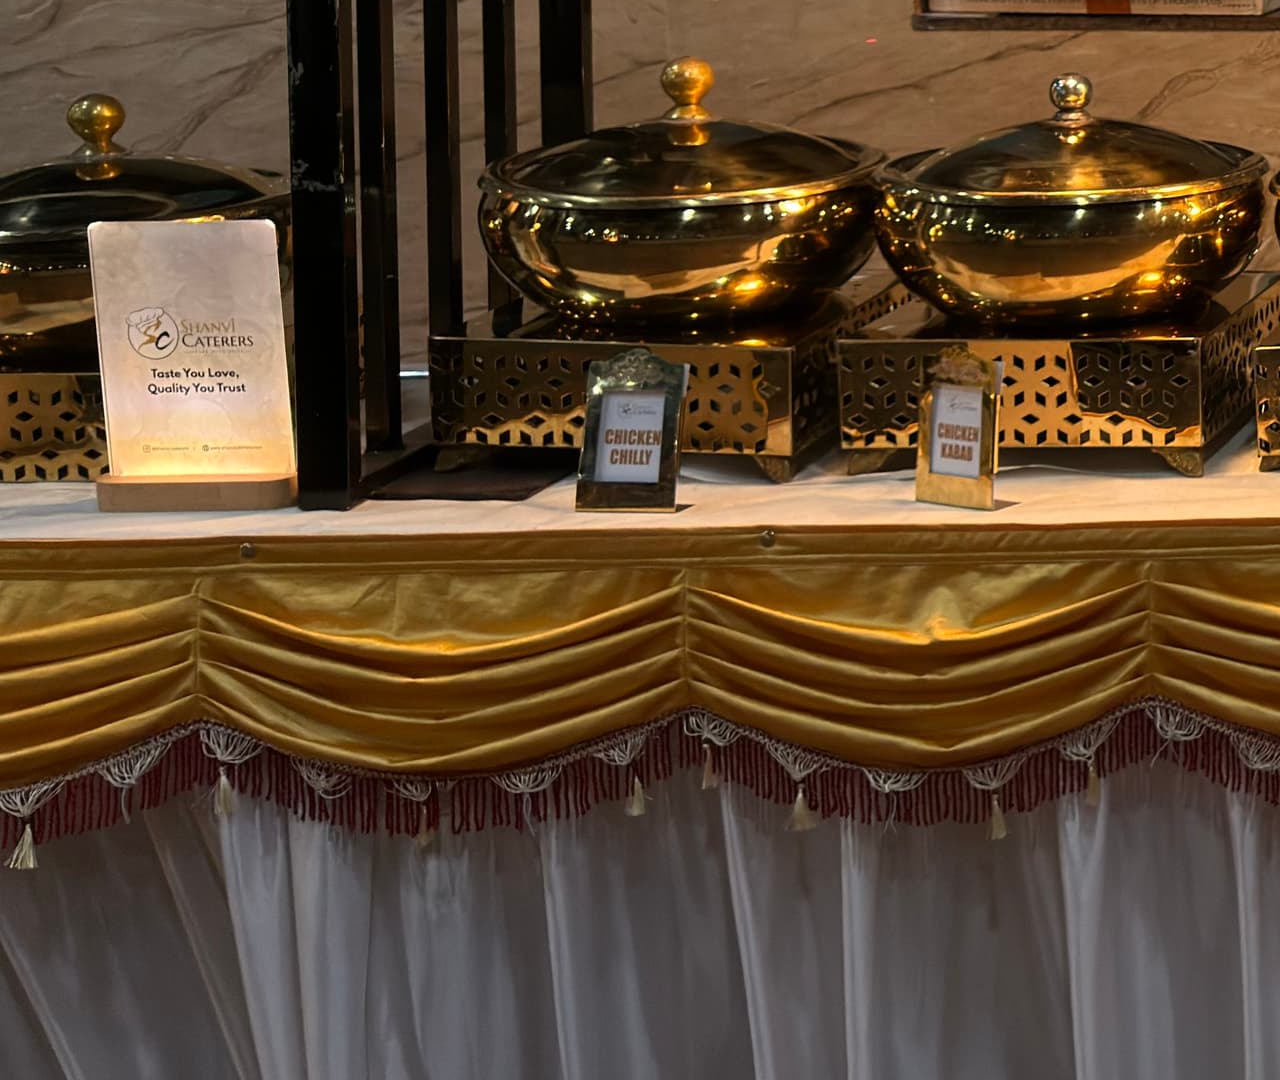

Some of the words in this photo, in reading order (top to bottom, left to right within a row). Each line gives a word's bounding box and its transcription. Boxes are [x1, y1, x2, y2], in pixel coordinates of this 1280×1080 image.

[182, 333, 254, 348] CATERERS
[151, 368, 181, 378] Taste
[183, 368, 205, 378] You
[208, 367, 240, 379] Love,
[147, 383, 190, 395] Quality
[192, 383, 214, 393] You
[217, 383, 246, 393] Trust
[605, 428, 662, 446] CHICKEN
[938, 422, 978, 442] CHICKEN
[610, 448, 652, 465] CHILLY
